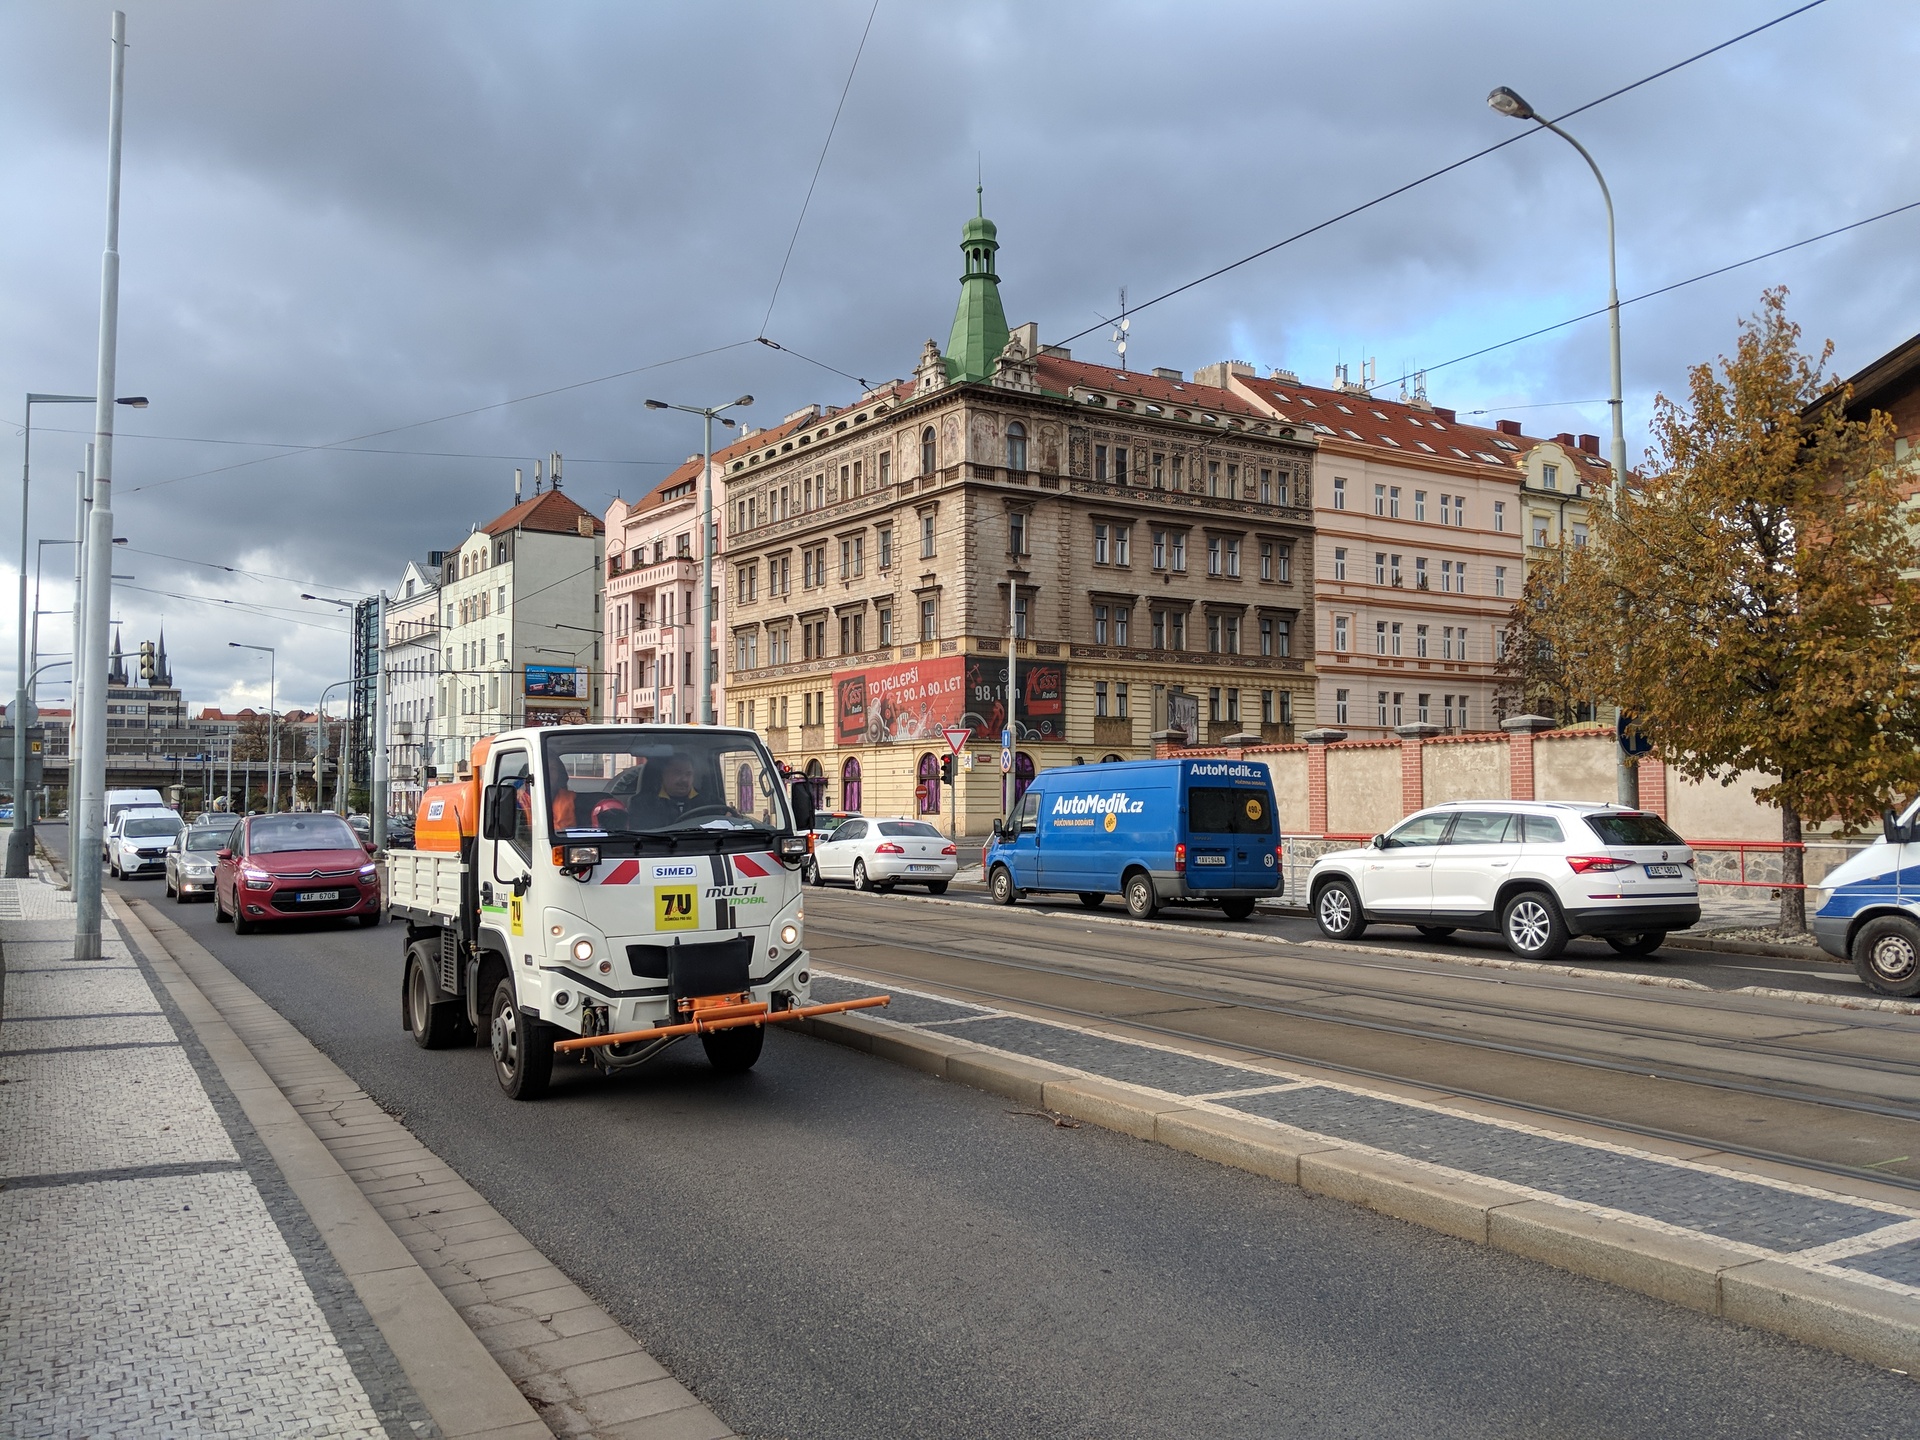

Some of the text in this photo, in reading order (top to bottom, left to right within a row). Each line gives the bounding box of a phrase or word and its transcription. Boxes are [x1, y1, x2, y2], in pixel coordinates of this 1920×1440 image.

[868, 666, 919, 695] TO NEJLEPŠÍ
[896, 676, 962, 704] Z 90. A 80. LET
[975, 685, 1001, 702] 98,1
[1042, 691, 1058, 699] Radio
[536, 712, 558, 721] KFC
[1190, 763, 1262, 778] AutoMedik.cz
[430, 804, 443, 816] SIMED
[1052, 793, 1144, 815] AutoMedik.cz
[1265, 854, 1273, 865] 31
[656, 867, 694, 876] SIMED
[661, 894, 692, 916] 7U
